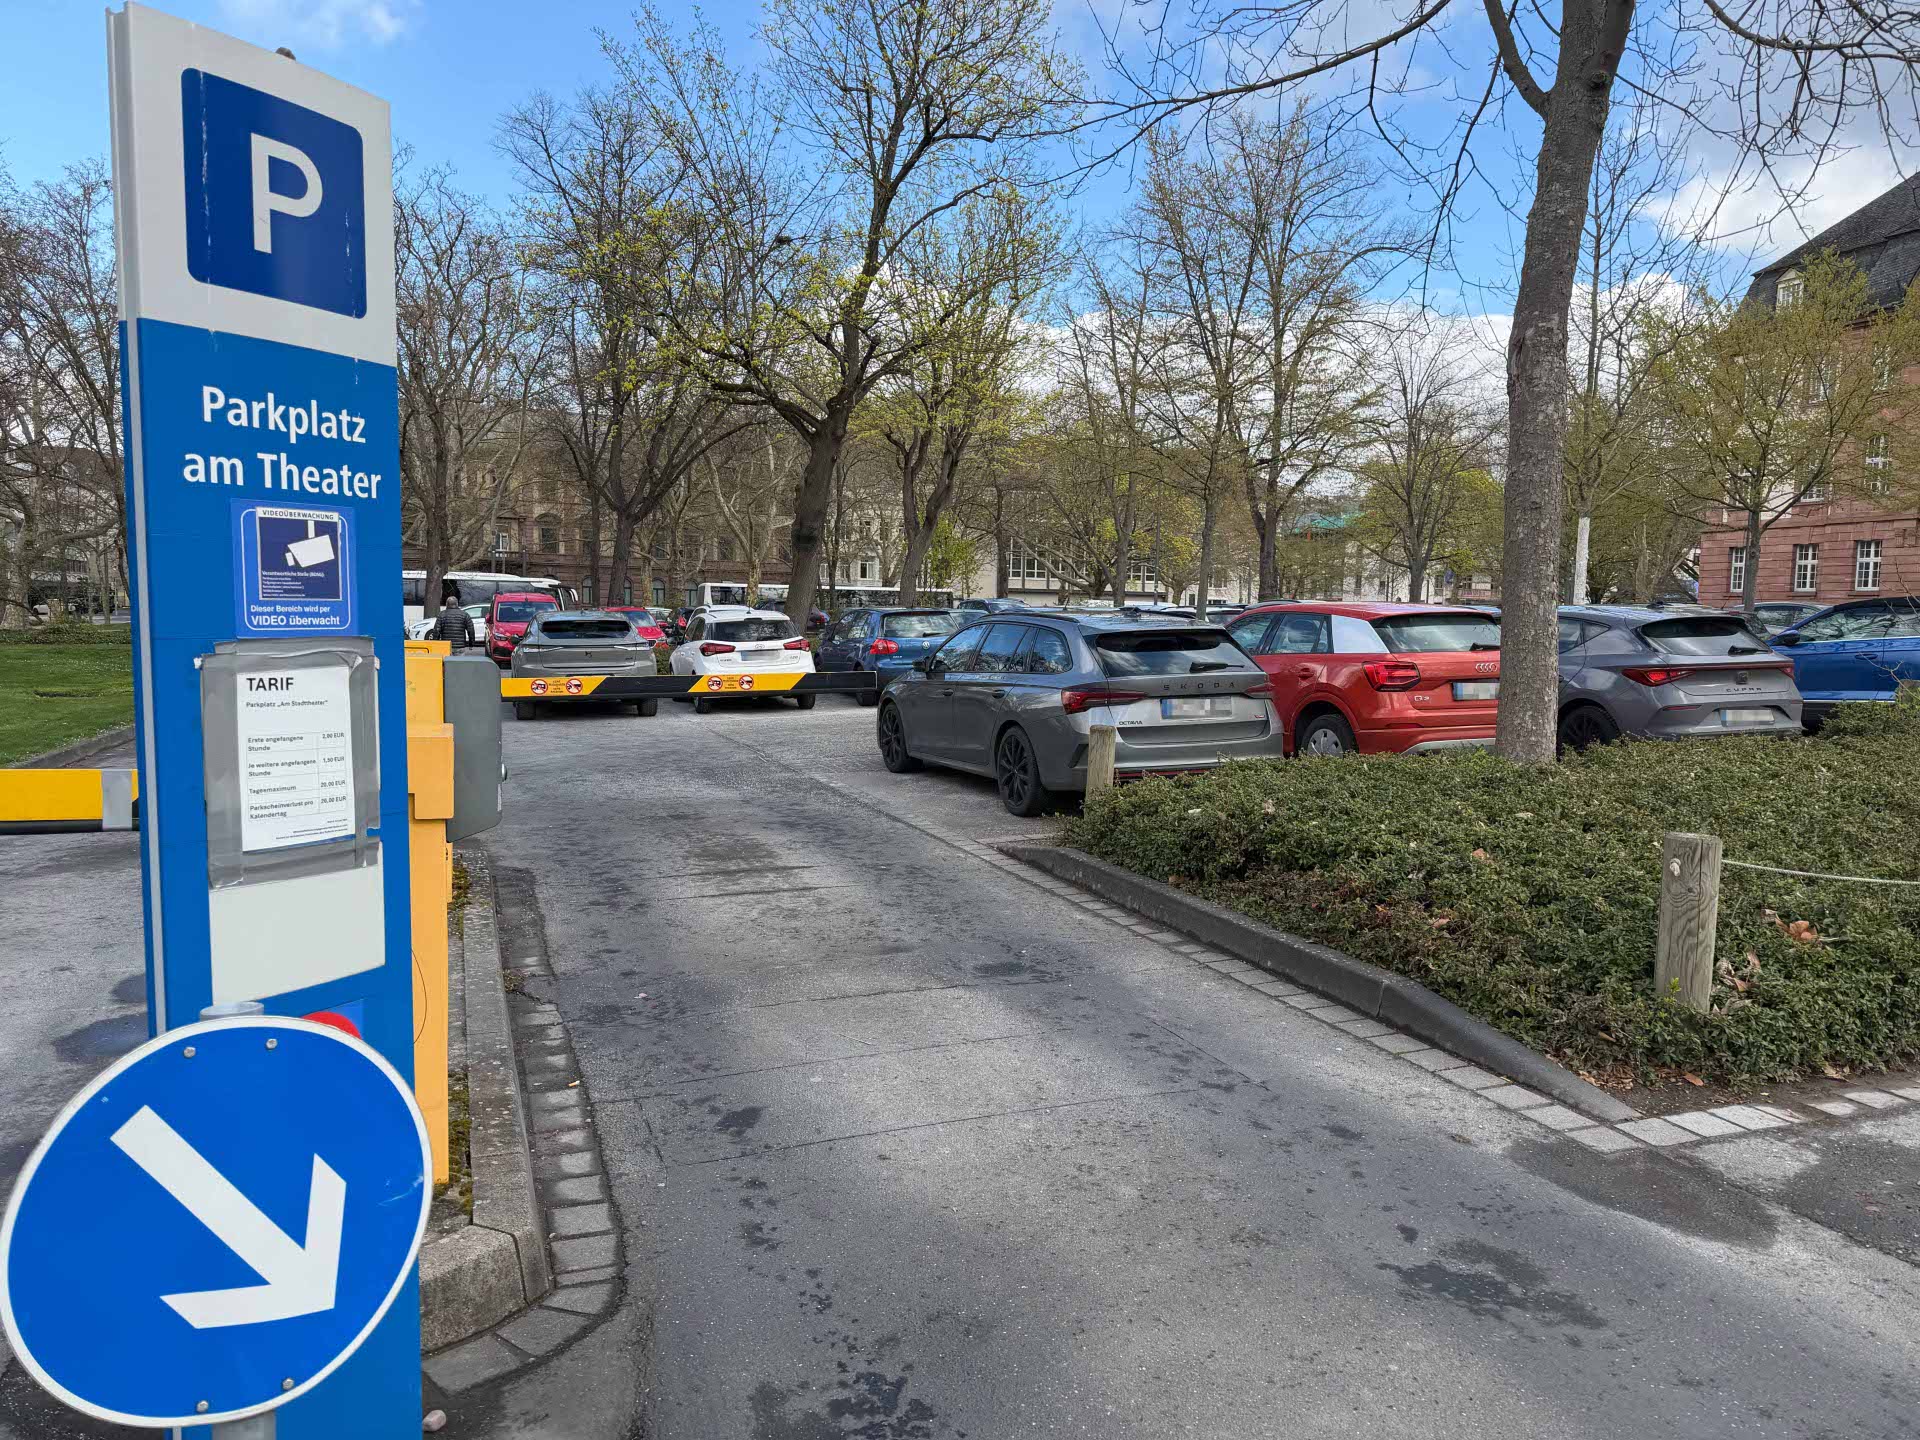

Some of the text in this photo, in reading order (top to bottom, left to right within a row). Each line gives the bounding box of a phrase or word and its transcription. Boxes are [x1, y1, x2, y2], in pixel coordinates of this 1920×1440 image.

[250, 132, 323, 253] P
[202, 385, 366, 444] Parkplatz
[183, 452, 382, 499] am Theater
[262, 509, 334, 520] VIDEOÜBERWACHUNG
[251, 605, 331, 614] Dieser Bereich wird per
[251, 615, 340, 626] VIDEO überwacht
[246, 677, 294, 691] TARIF
[266, 736, 303, 744] angefangene
[281, 759, 317, 767] angefangene
[249, 786, 297, 795] Tagesmaximum
[250, 801, 303, 811] Parkscheinverlust
[250, 811, 287, 819] Kalendertag
